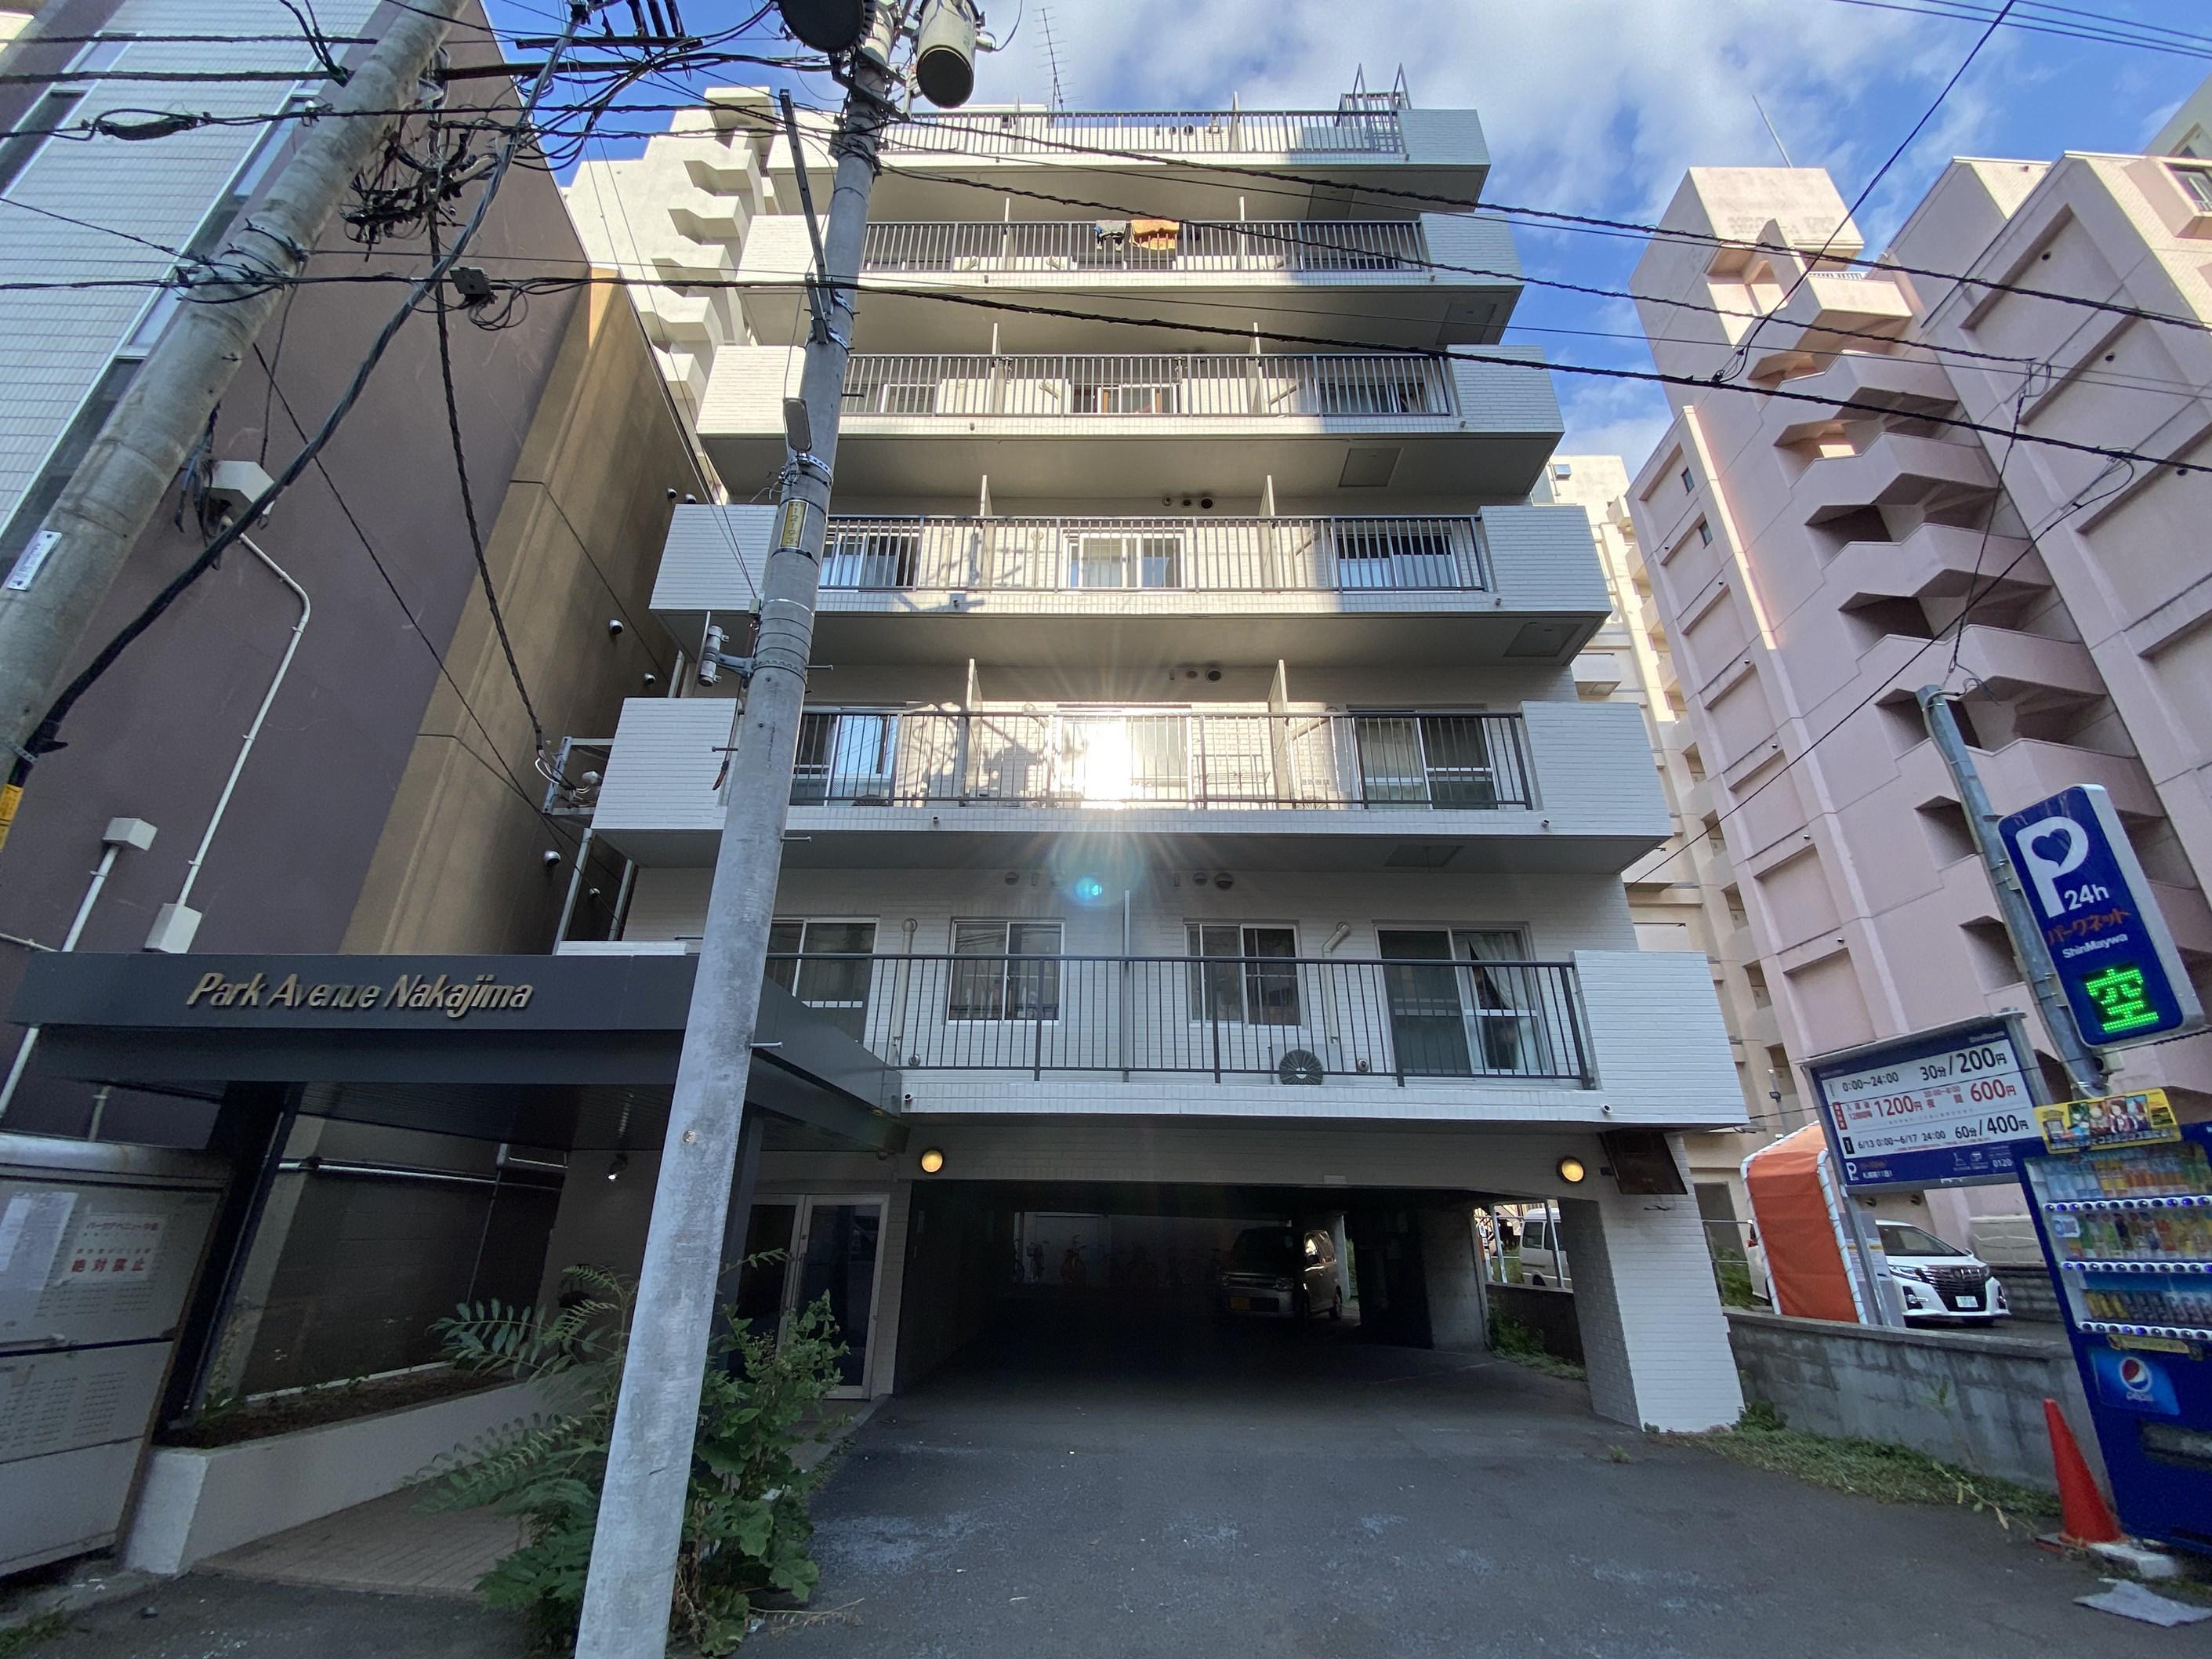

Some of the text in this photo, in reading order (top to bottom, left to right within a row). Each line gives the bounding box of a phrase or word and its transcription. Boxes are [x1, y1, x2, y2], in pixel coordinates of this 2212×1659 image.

[2064, 884, 2110, 909] 24h
[2047, 908, 2131, 944] パークネット
[2062, 933, 2128, 959] ShinMaywa
[187, 972, 535, 1018] Park Avenue Nakajima
[2085, 968, 2159, 1033] 空
[1971, 1079, 2017, 1102] 600円
[1874, 1095, 1923, 1117] 1200円
[1922, 1131, 1945, 1142] 24:00
